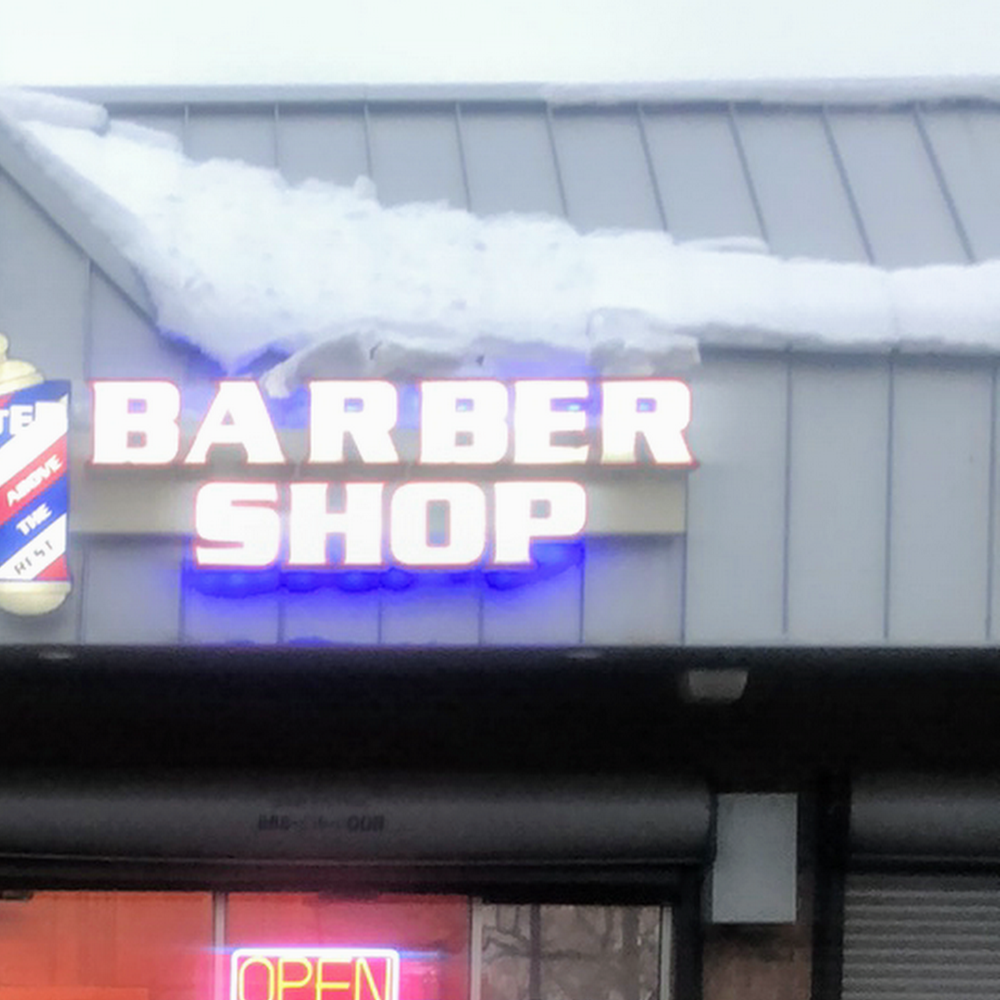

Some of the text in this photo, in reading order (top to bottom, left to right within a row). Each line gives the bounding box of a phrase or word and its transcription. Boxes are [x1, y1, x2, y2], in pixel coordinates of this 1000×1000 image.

[91, 378, 695, 466] BARBER
[15, 502, 53, 536] THE
[192, 479, 587, 568] SHOP
